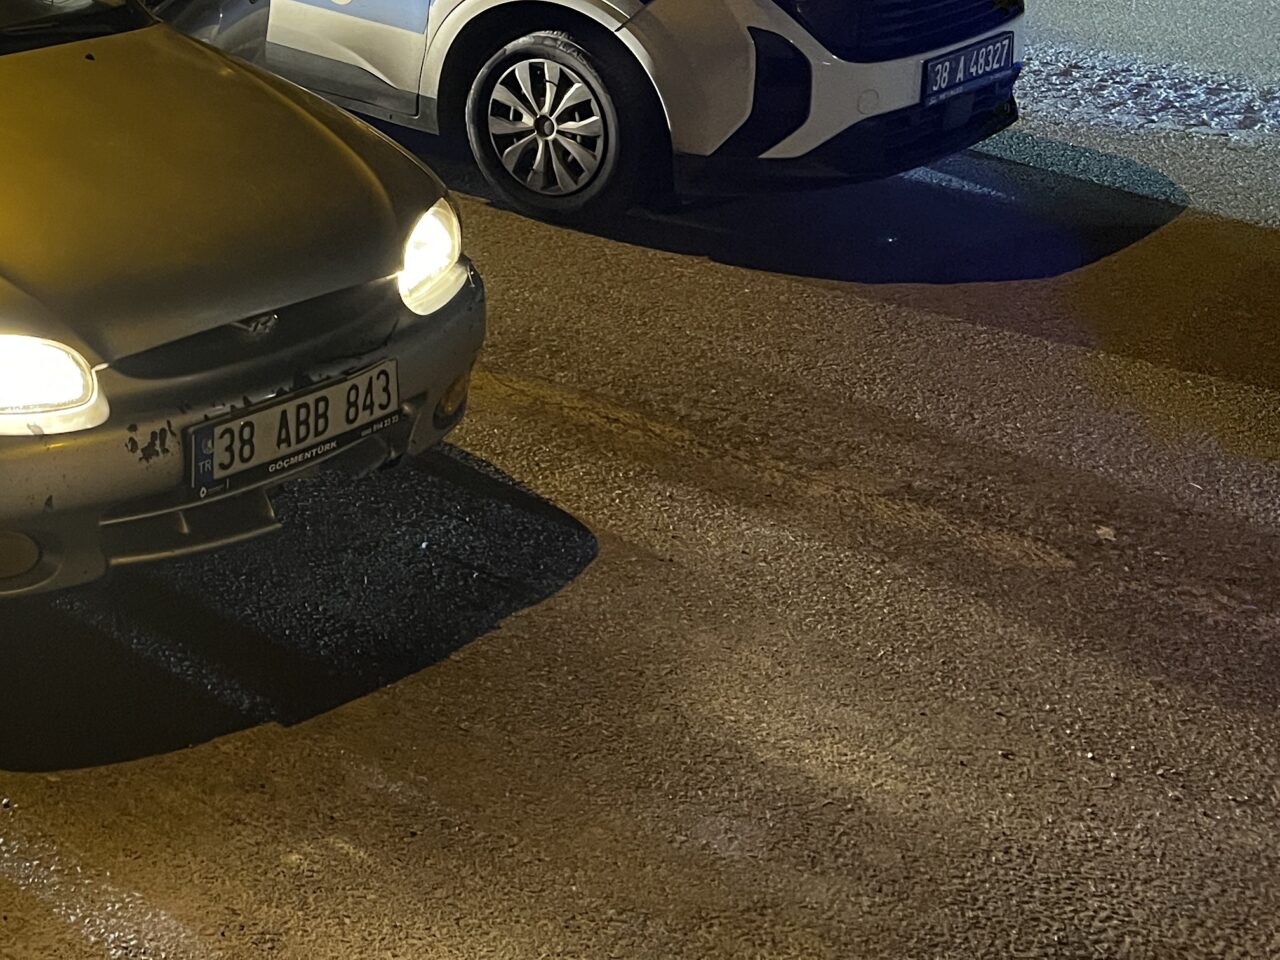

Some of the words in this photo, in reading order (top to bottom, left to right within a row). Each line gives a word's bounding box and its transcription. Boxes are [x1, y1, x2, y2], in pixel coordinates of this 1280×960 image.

[932, 61, 950, 91] 38
[955, 55, 965, 83] A
[969, 38, 1010, 77] 48327
[218, 420, 256, 471] 38
[275, 395, 330, 450] ABB
[345, 369, 392, 425] 843
[198, 458, 212, 474] TR
[268, 440, 338, 473] GÖÇMENTÜRK
